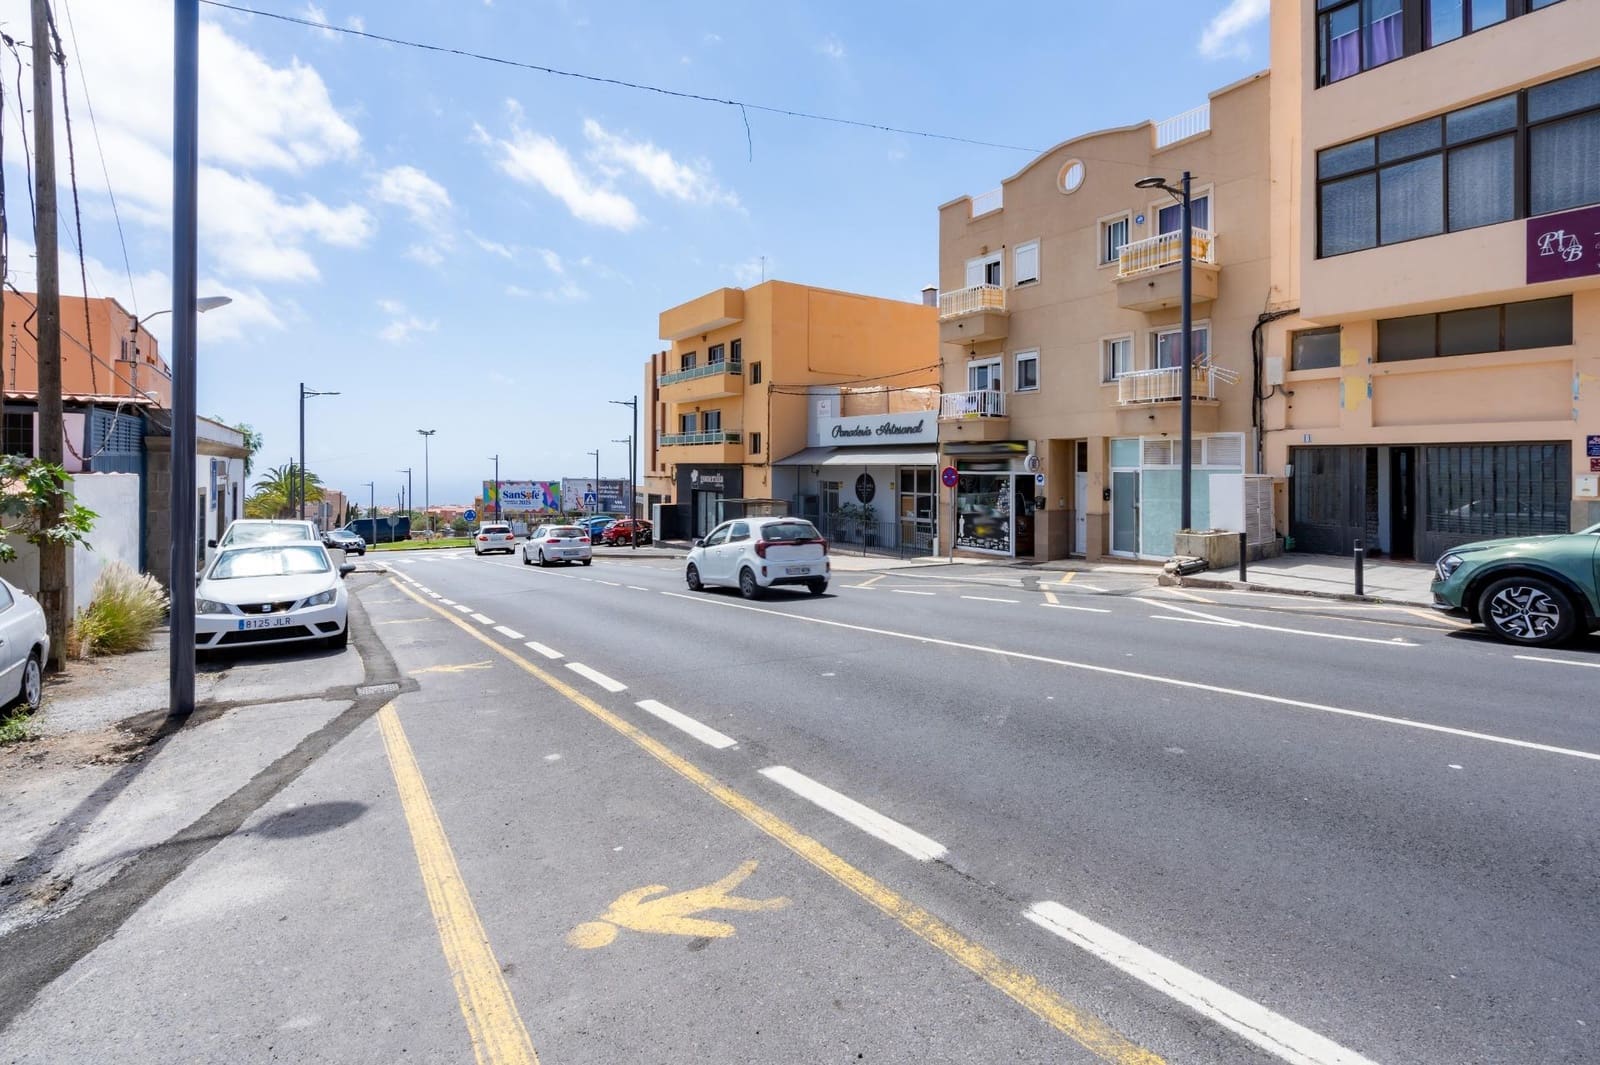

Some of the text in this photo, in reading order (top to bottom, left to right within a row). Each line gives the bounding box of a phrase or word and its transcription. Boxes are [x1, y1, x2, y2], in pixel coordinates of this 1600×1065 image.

[876, 419, 924, 436] Artesanal
[246, 617, 291, 628] 8125 JLR
